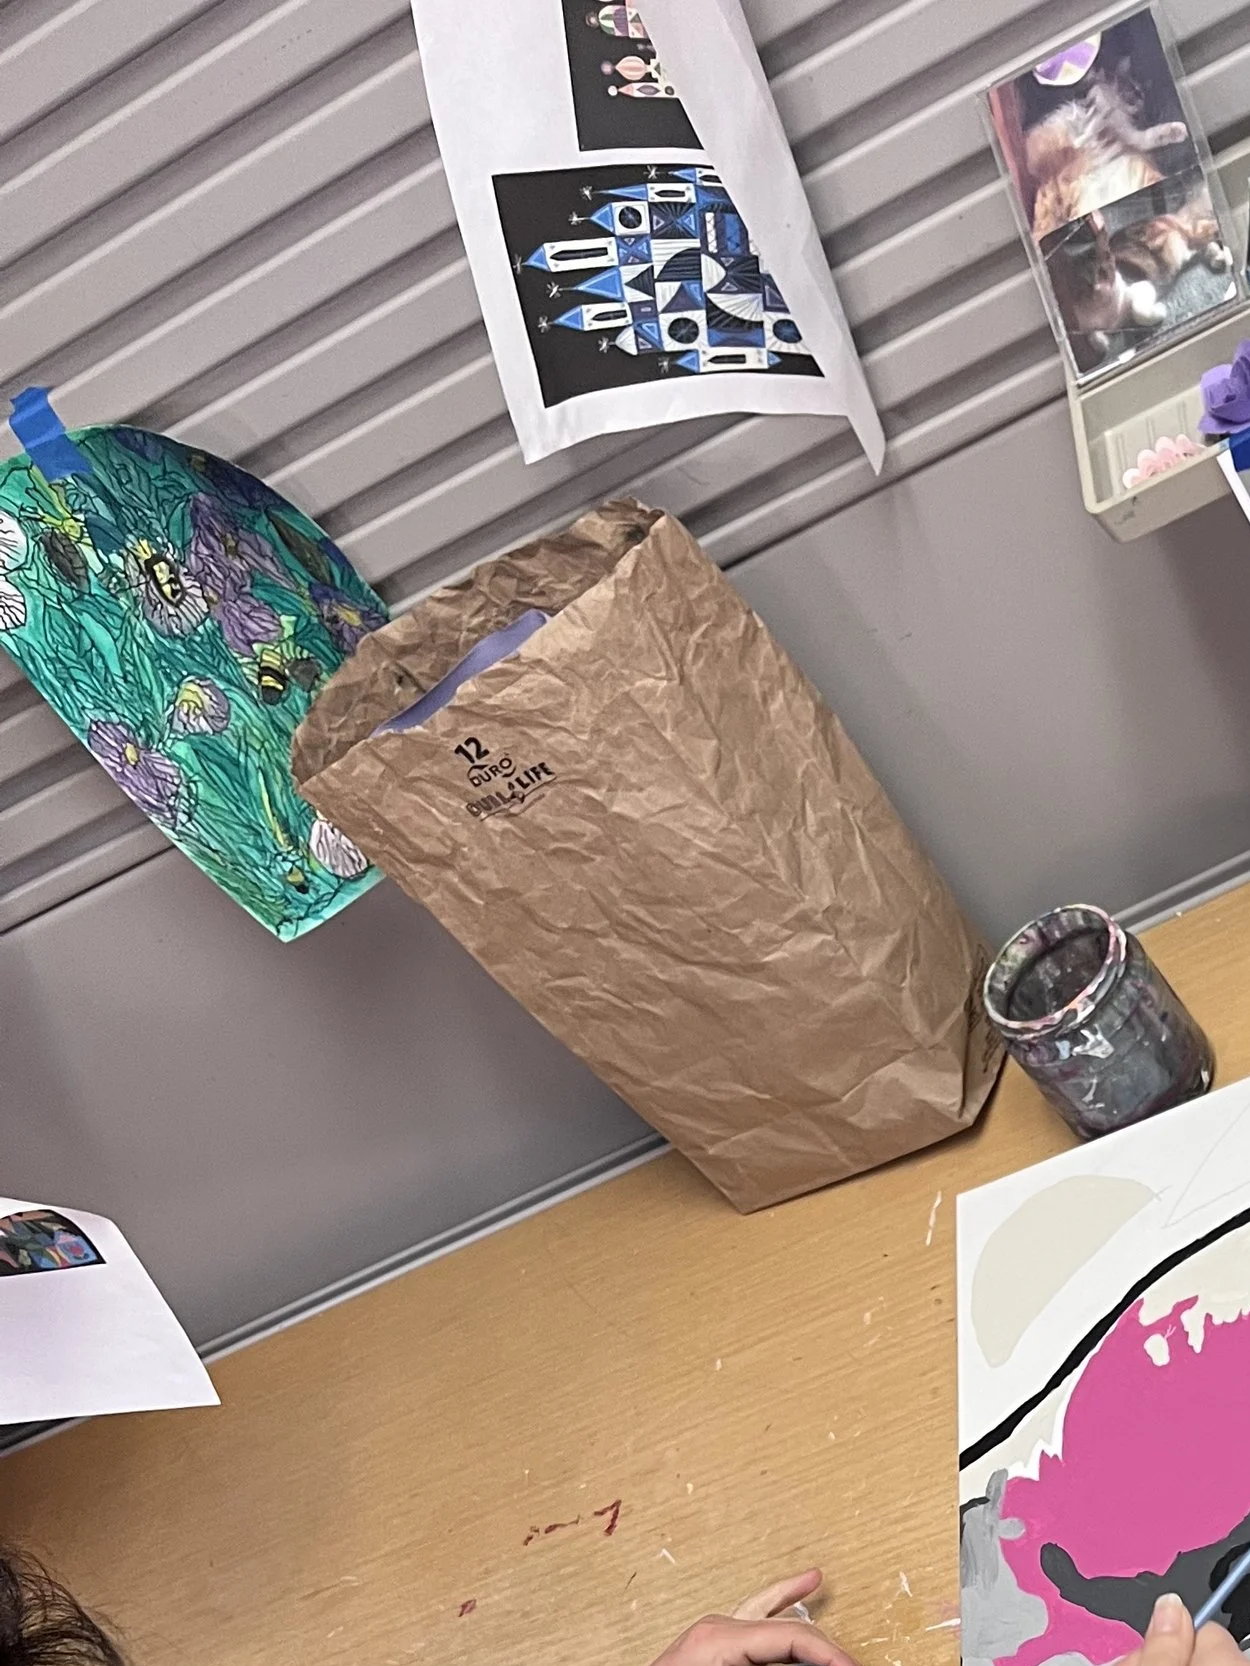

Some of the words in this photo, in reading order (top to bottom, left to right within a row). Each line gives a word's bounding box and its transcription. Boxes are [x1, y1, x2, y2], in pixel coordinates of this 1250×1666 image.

[454, 736, 490, 764] 12
[469, 757, 513, 788] DURO
[515, 761, 556, 790] LIFE
